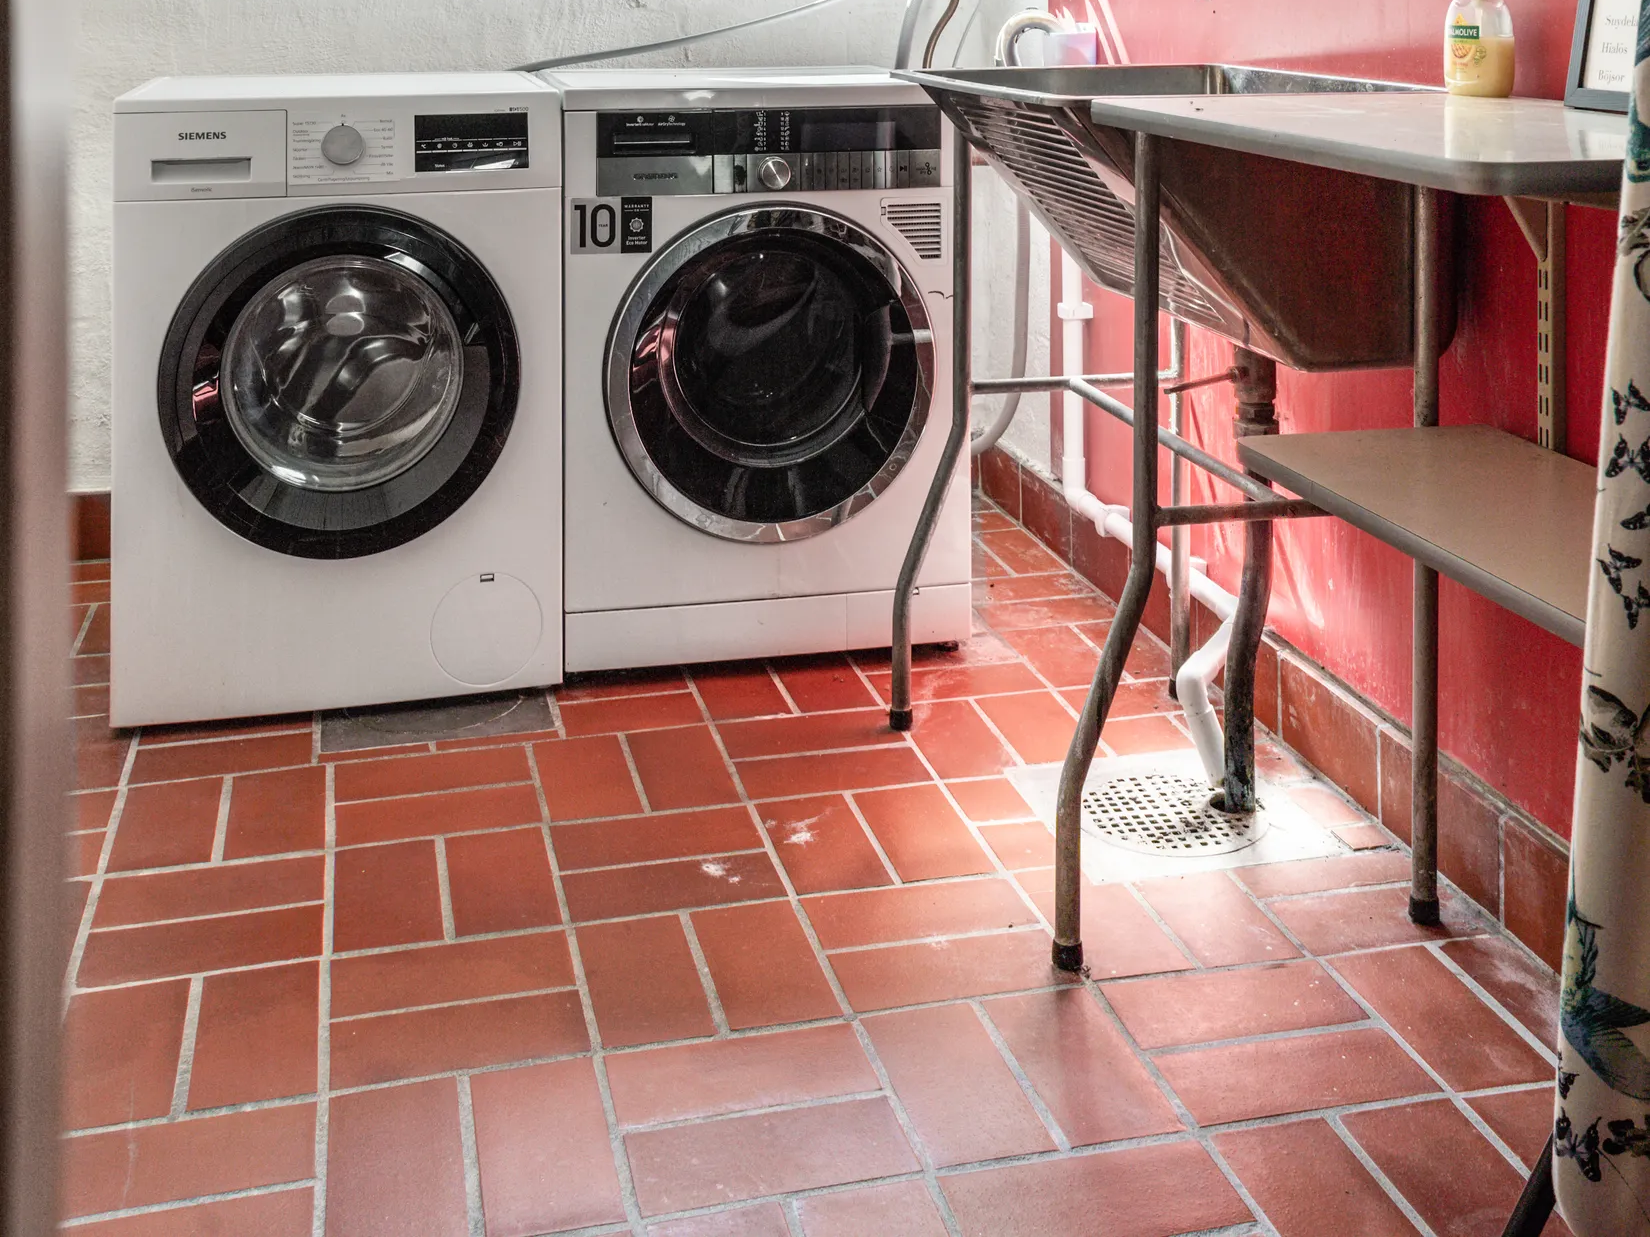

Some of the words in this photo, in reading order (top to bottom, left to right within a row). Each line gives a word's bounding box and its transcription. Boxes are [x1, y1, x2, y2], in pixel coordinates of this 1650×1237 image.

[1598, 70, 1625, 84] Böjsor
[178, 131, 227, 141] SIEMENS
[574, 204, 616, 248] 10
